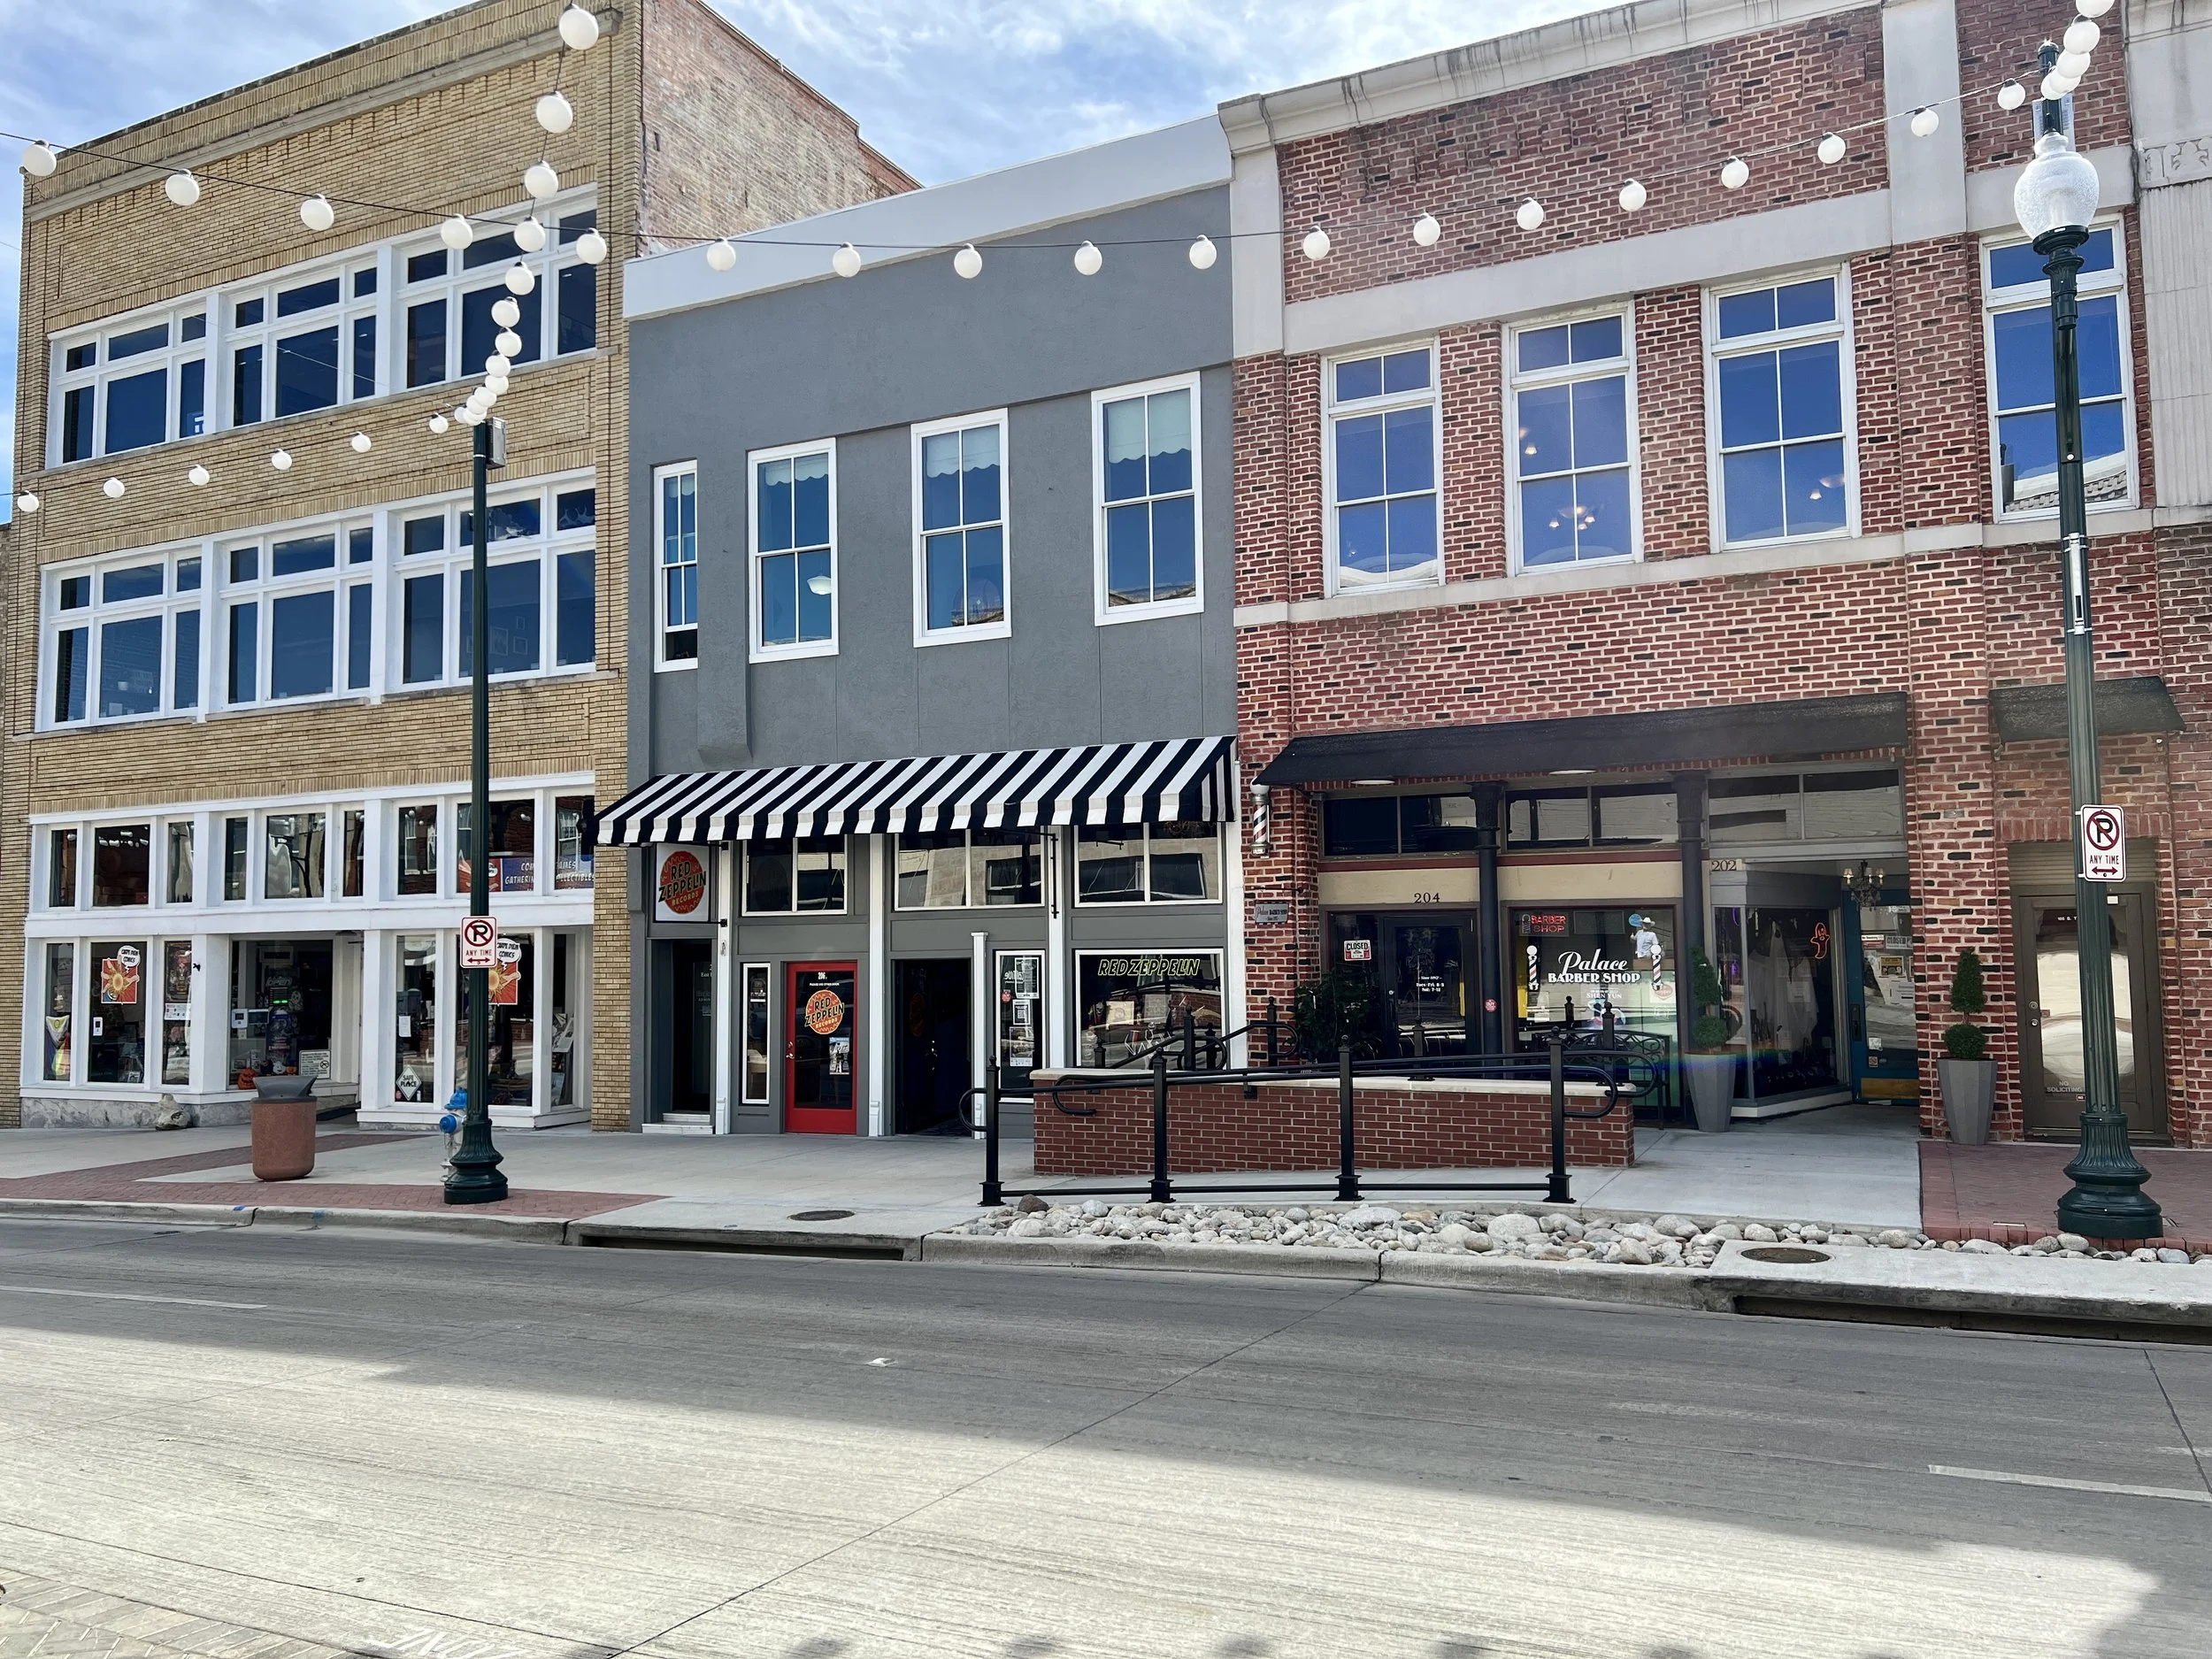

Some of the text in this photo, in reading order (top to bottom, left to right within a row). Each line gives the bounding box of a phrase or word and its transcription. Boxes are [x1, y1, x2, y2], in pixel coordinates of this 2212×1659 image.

[1711, 859, 1736, 872] 202
[2089, 855, 2120, 865] ANY TIME
[671, 862, 690, 881] RED
[658, 871, 707, 902] ZEPPELIN
[672, 891, 699, 905] RECORDS
[1414, 892, 1440, 903] 204
[1531, 915, 1566, 925] BARBER
[1346, 942, 1369, 951] CLOSED
[1097, 958, 1201, 976] RED ZEPPELIN
[1558, 949, 1629, 975] Palace
[1548, 972, 1640, 983] BARBER SHOP
[815, 997, 831, 1011] RED
[804, 1002, 845, 1027] ZEPPELIN
[815, 1017, 838, 1029] RECORDS
